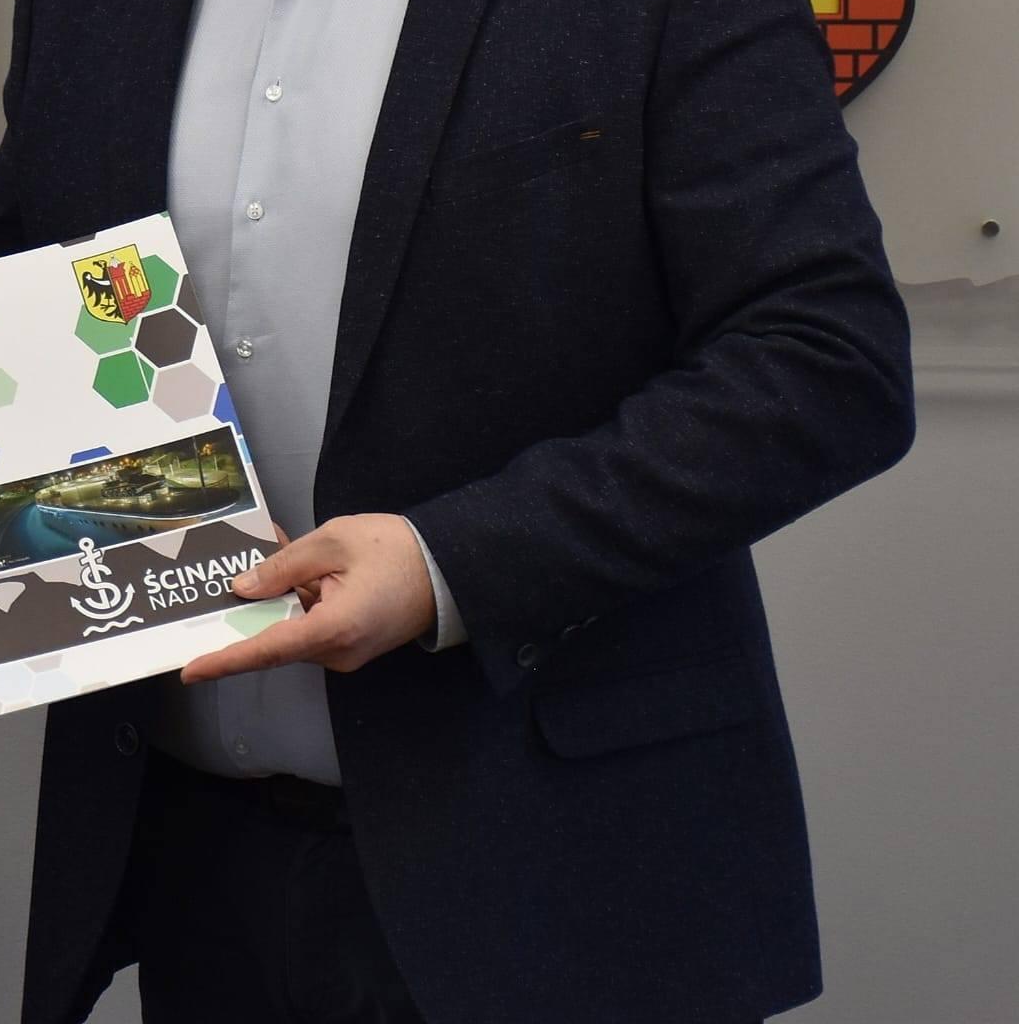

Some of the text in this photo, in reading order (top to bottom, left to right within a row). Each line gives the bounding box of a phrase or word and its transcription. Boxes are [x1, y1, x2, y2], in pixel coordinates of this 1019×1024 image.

[143, 547, 266, 595] ŚCINAWA
[148, 576, 235, 611] NAD OD
